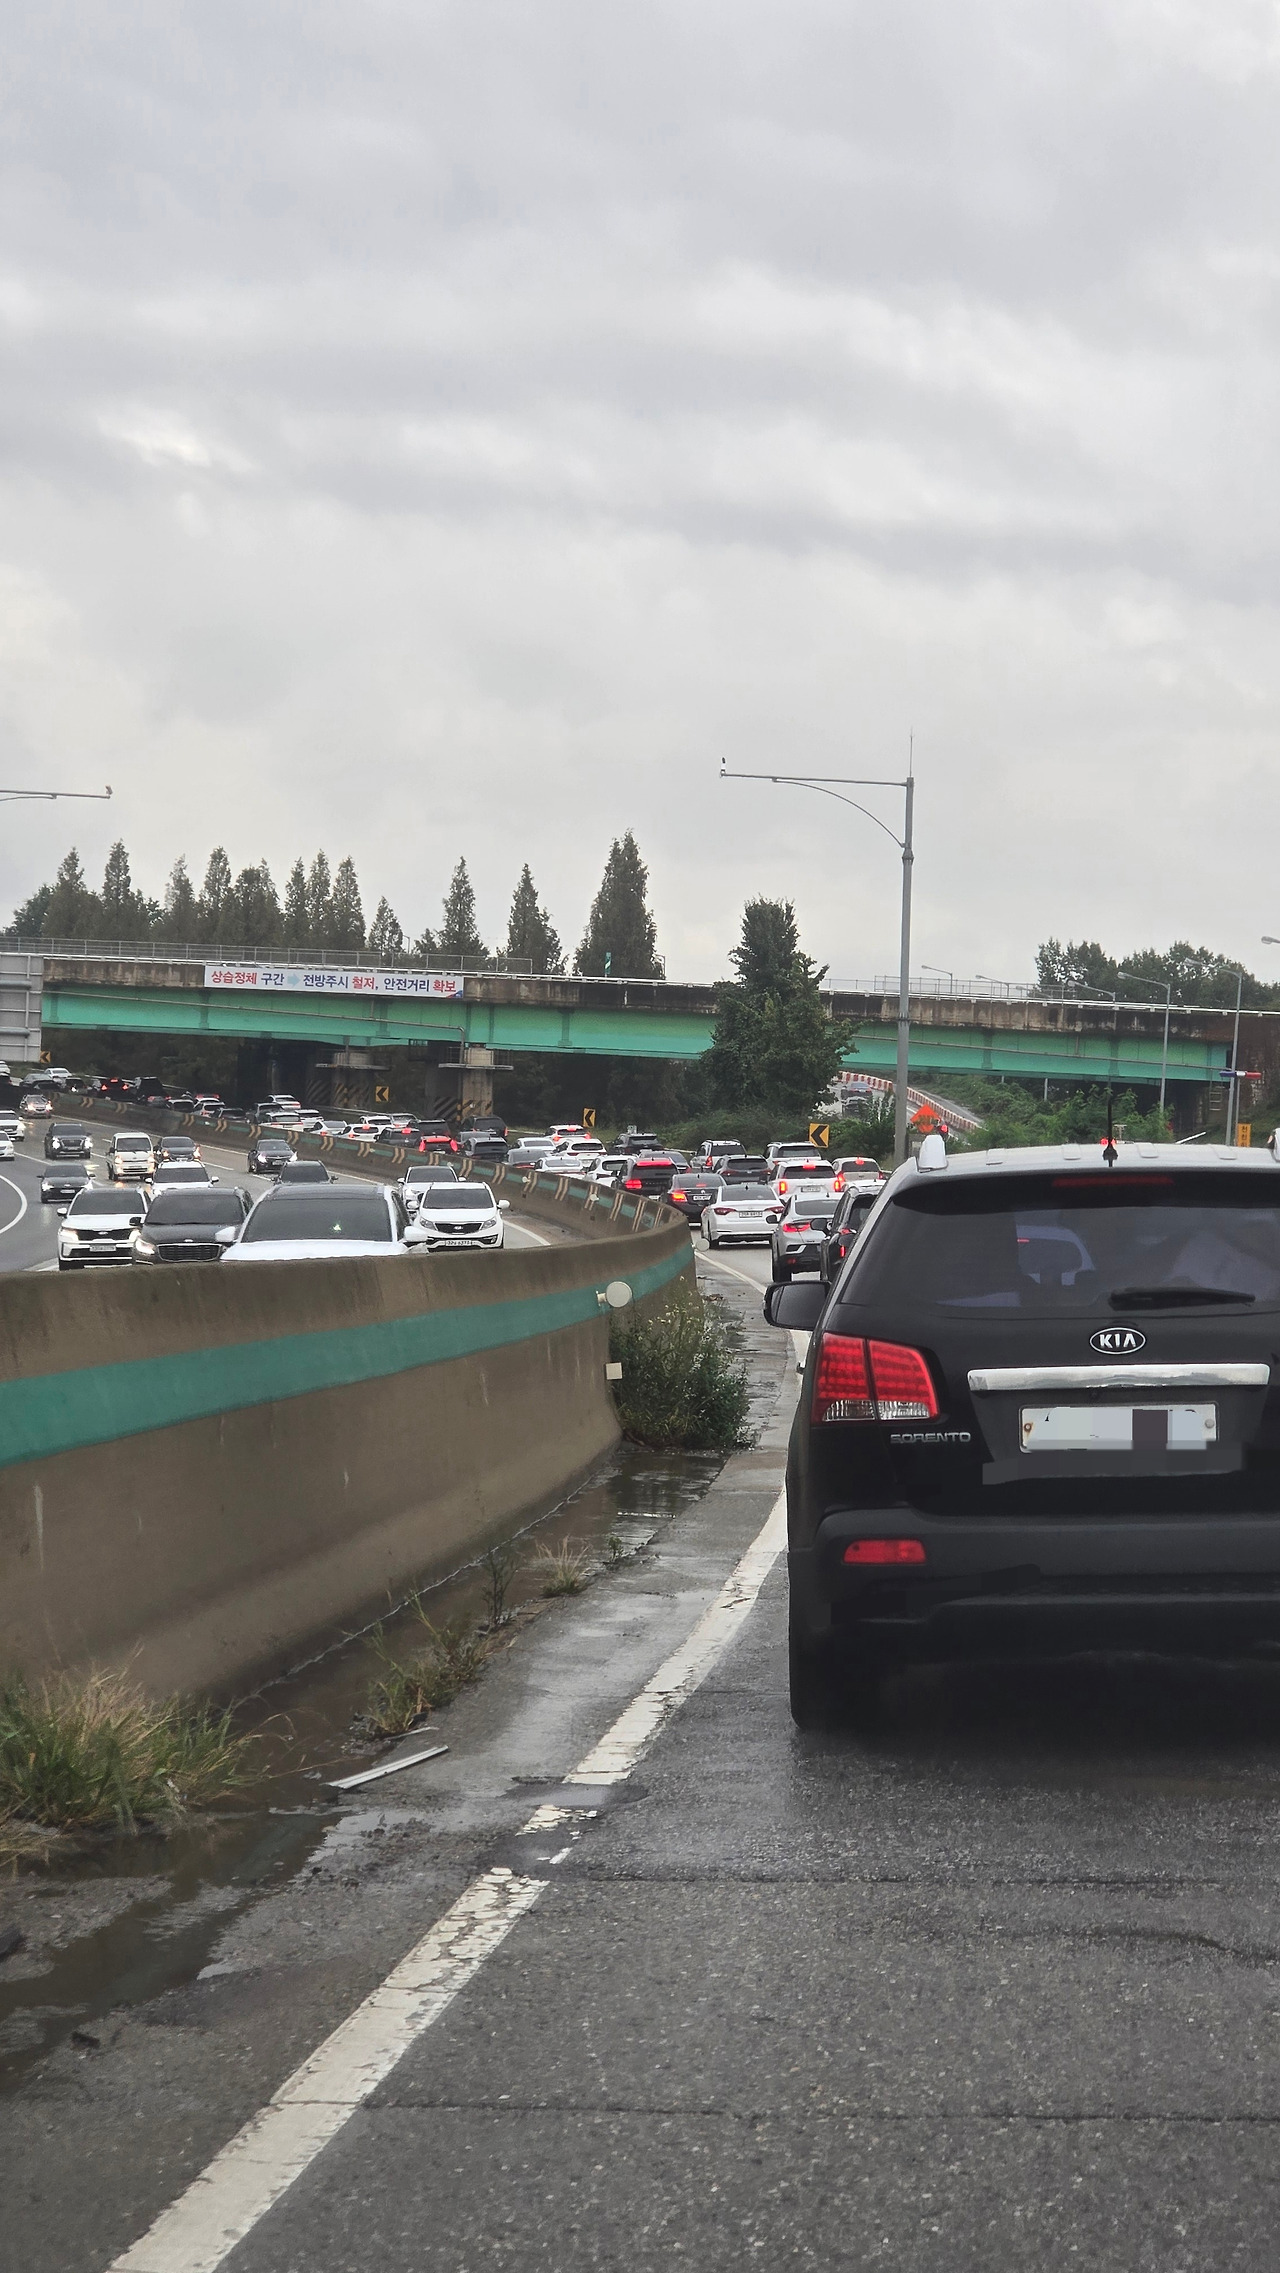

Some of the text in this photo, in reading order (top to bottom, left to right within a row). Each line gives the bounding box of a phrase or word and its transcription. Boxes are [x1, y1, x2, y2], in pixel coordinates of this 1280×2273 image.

[211, 970, 457, 993] 상습정체 구간 전방주시 철저, 안전거리 확보
[1100, 1333, 1136, 1348] KIA
[890, 1432, 971, 1444] SORENTO
